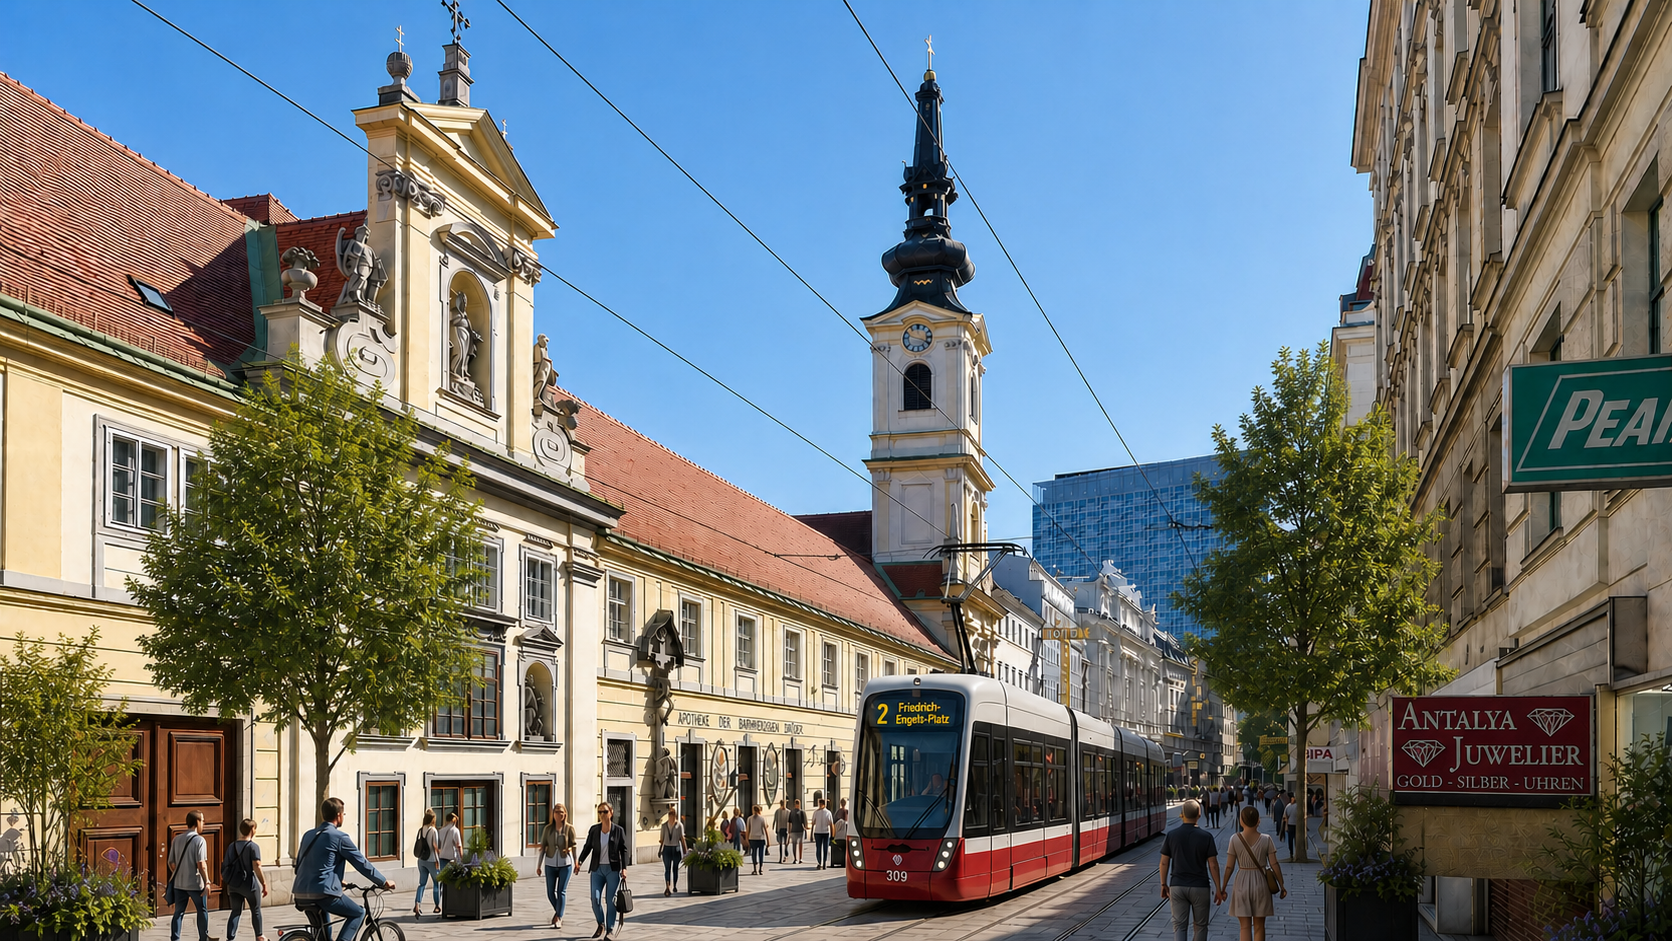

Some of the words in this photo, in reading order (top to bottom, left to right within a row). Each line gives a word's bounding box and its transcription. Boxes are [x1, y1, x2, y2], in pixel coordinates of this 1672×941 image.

[877, 703, 889, 724] 2
[898, 702, 941, 713] Friedrich-
[678, 712, 710, 727] APOTHEKE
[719, 716, 731, 728] DER
[1398, 702, 1518, 730] ANTALYA
[1449, 736, 1584, 773] JUWELIER
[1397, 775, 1443, 788] GOLD
[1457, 776, 1510, 790] SILBER
[1524, 777, 1584, 790] UHREN
[886, 870, 907, 882] 309
